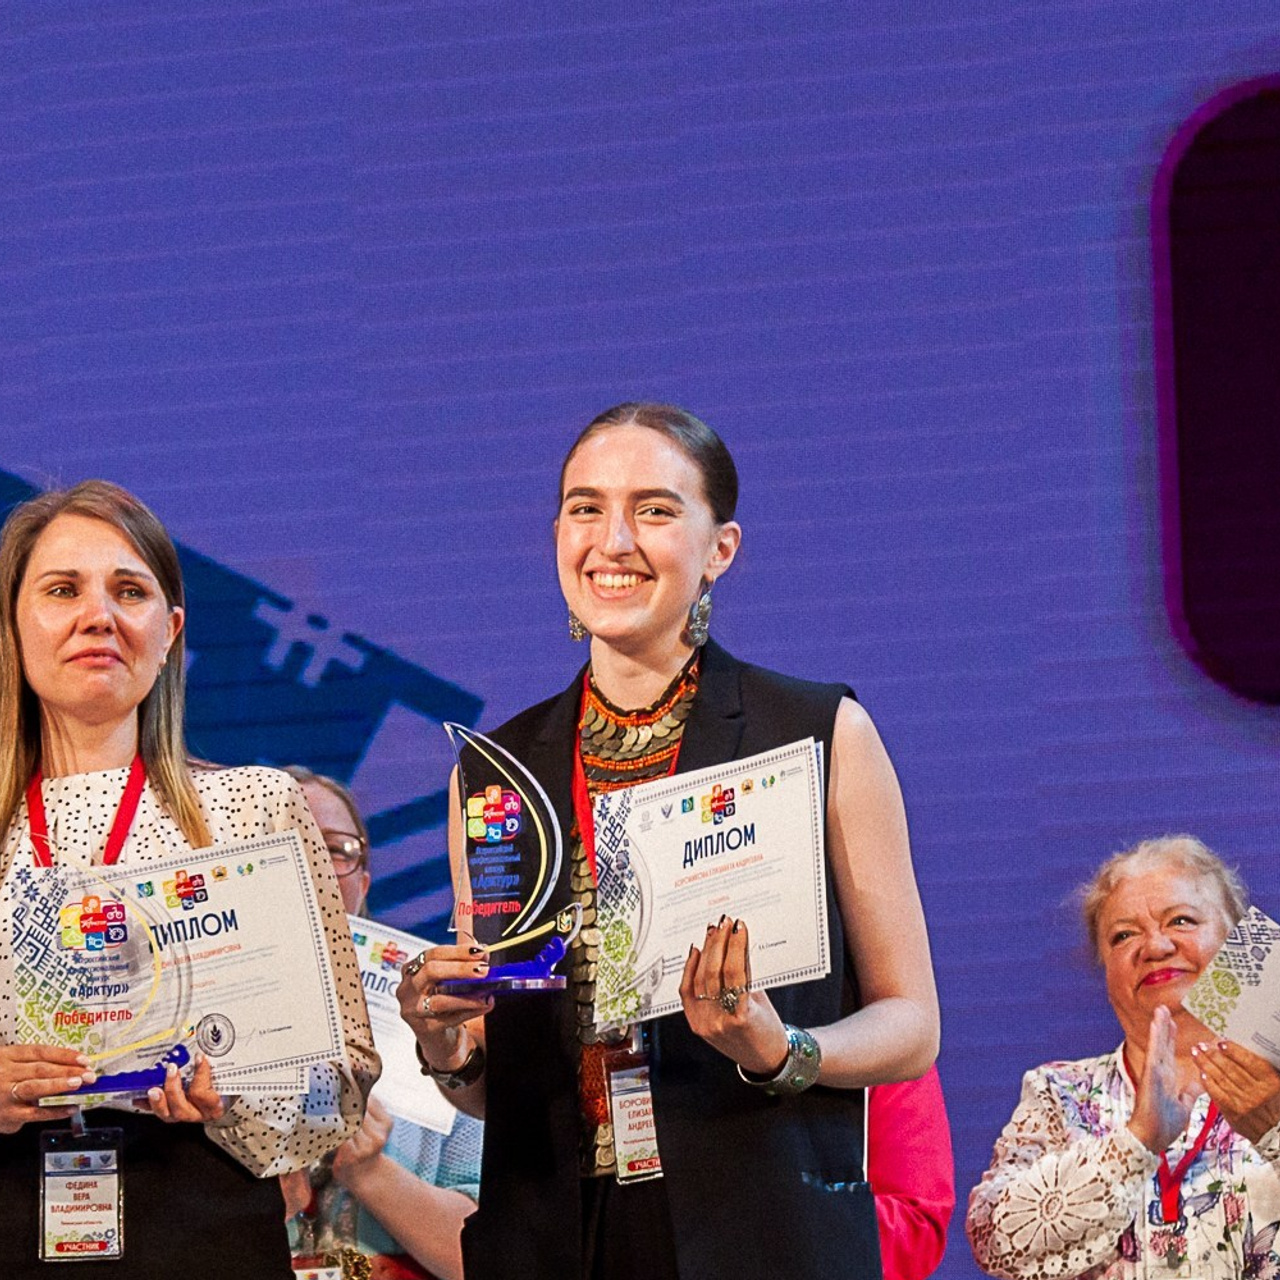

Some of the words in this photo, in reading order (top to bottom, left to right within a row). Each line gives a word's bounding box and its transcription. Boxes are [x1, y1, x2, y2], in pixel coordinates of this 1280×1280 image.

[683, 823, 755, 869] ДИПЛОМ
[458, 901, 522, 917] Победитель
[149, 909, 239, 953] ДИПЛОМ
[69, 984, 129, 999] «Арктур»
[55, 1009, 132, 1026] Победитель
[63, 1243, 99, 1252] УЧАСТНИК
